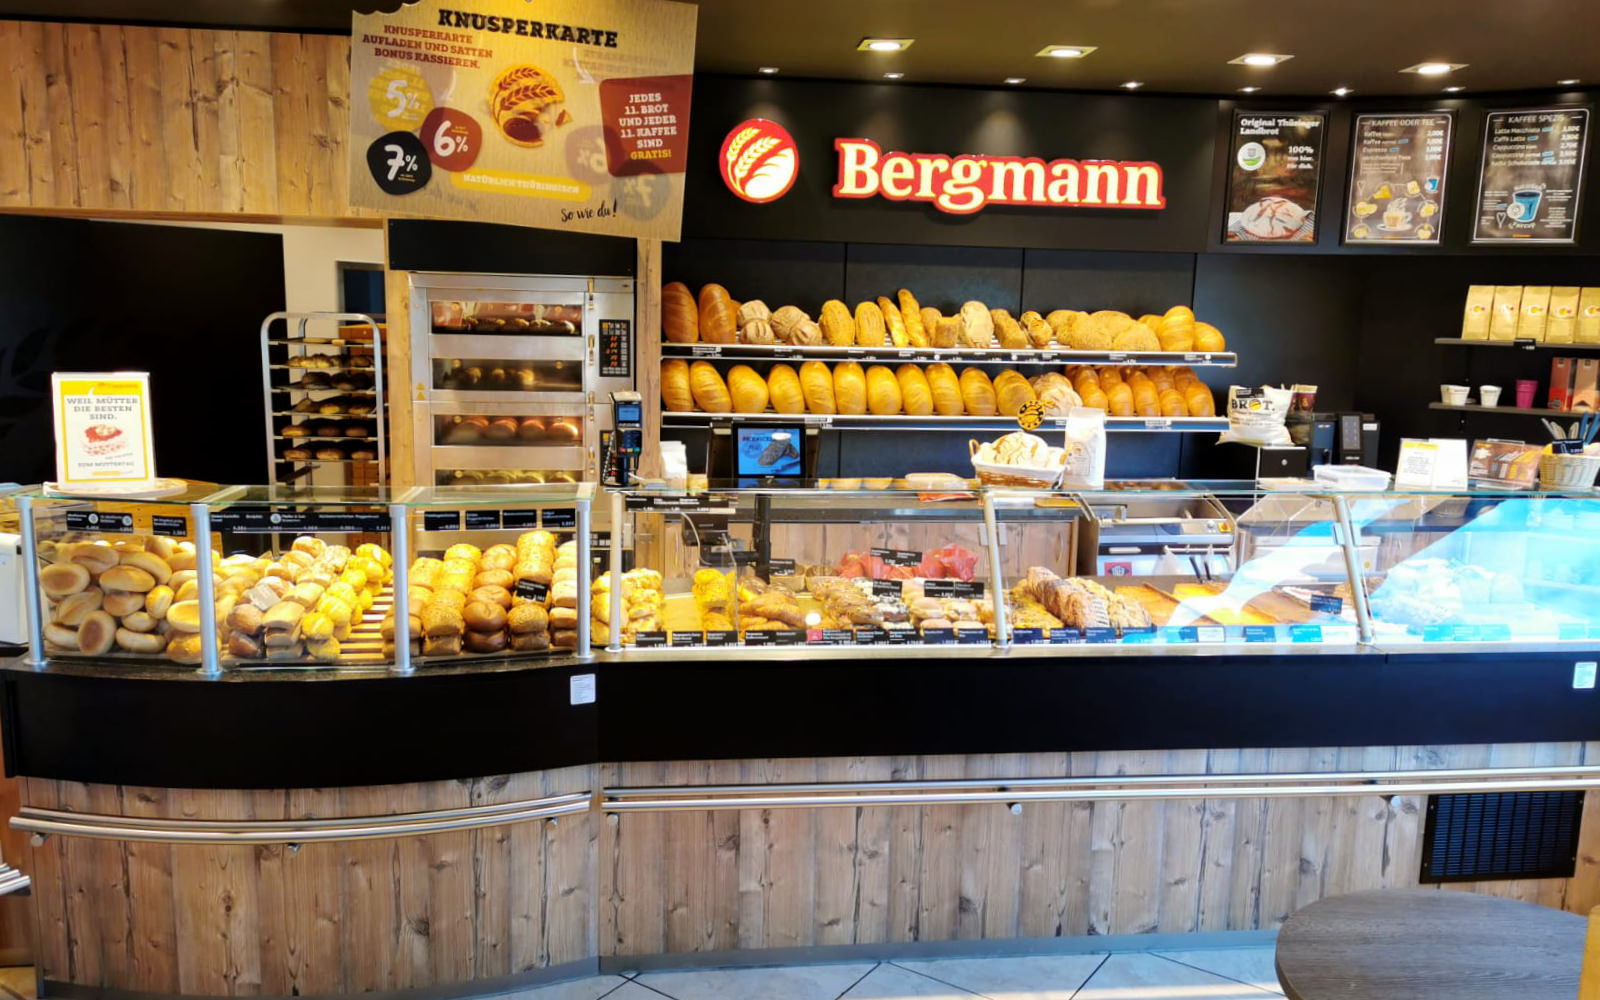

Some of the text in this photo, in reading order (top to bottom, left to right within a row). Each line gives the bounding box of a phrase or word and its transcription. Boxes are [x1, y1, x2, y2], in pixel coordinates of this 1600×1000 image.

[438, 9, 618, 48] KNUSPERKARTE
[384, 25, 472, 44] KNUSPERKARTE
[362, 34, 493, 58] AUFLADEN UND SATTEN
[374, 48, 480, 69] BONUS KASSIEREN.
[387, 80, 420, 118] 5%
[629, 93, 662, 103] JEDES
[624, 104, 669, 115] 11. BROT
[618, 115, 676, 126] UND JEDER
[1241, 118, 1276, 128] Original
[1508, 115, 1537, 123] KAFFEE
[620, 126, 677, 138] 11. KAFFEE
[1240, 127, 1280, 135] Landbrot
[433, 120, 469, 157] 6%
[636, 139, 663, 148] SIND
[631, 149, 672, 160] GRATIS!
[1288, 145, 1314, 154] 100%
[384, 144, 418, 180] 7%
[836, 141, 1164, 211] Bergmann
[561, 208, 574, 222] So
[576, 209, 593, 219] wie
[96, 396, 138, 404] MÜTTER
